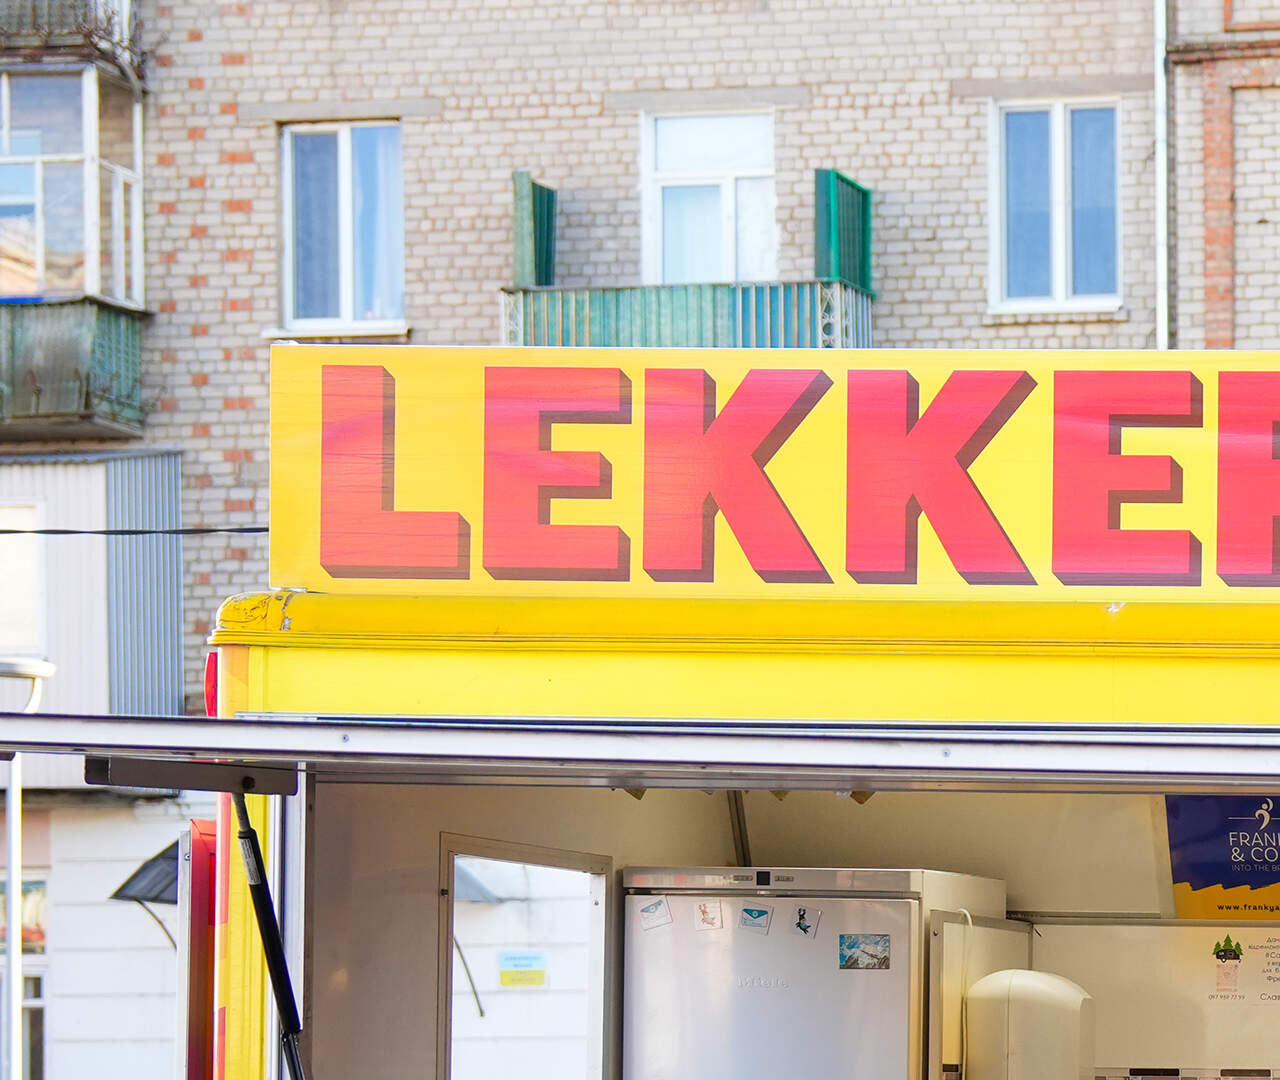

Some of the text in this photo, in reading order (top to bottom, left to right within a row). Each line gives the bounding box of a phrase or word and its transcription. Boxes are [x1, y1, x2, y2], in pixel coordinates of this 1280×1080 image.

[1231, 847, 1245, 862] &
[1231, 864, 1251, 872] INTO
[1254, 864, 1270, 872] THE
